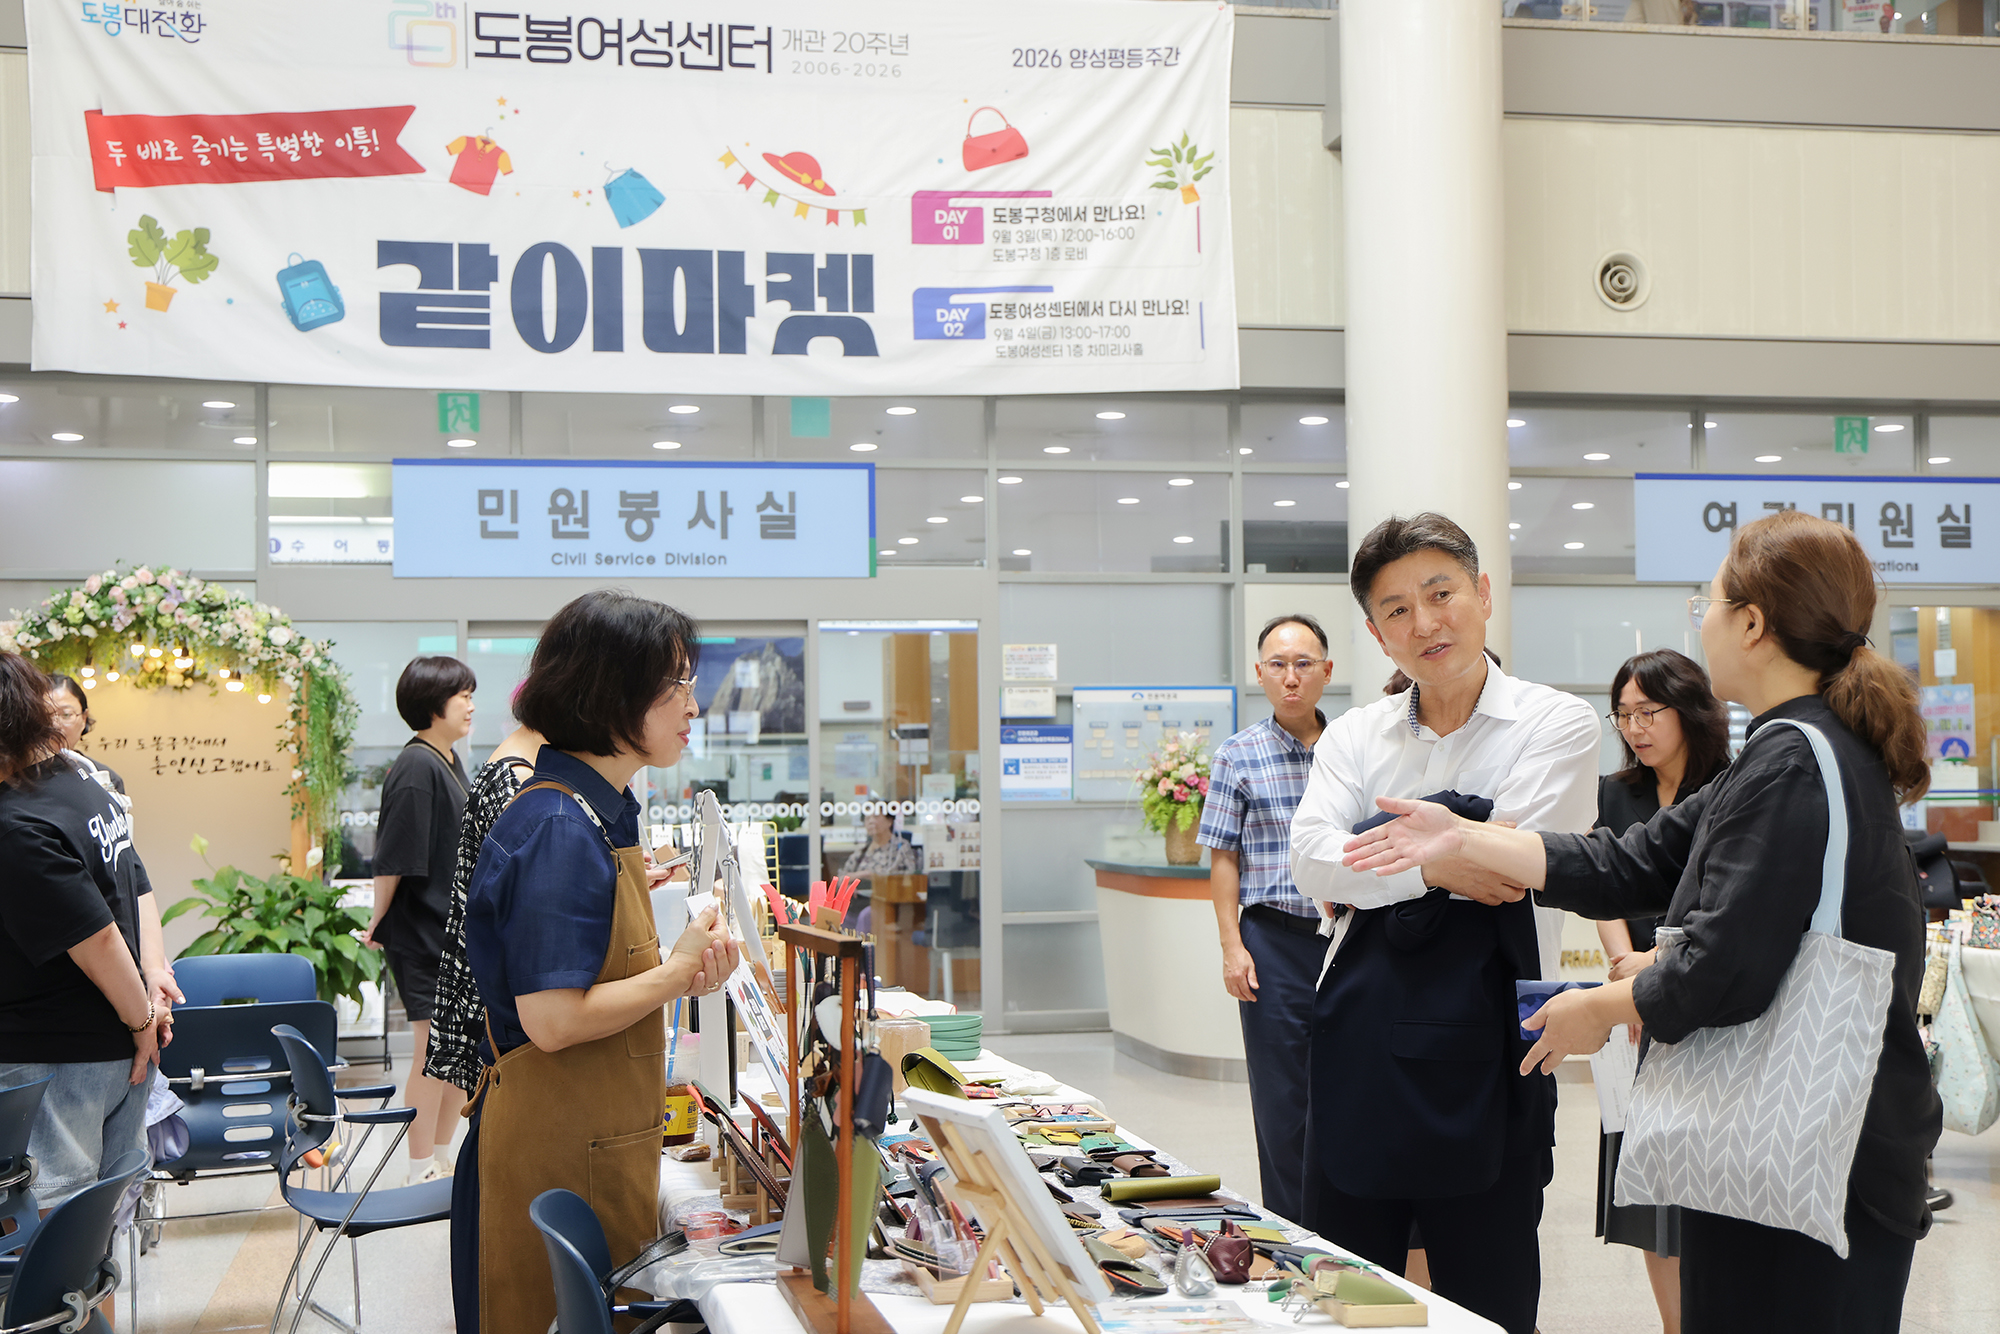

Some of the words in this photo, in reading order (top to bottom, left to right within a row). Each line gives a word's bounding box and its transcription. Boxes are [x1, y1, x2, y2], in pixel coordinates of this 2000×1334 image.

[80, 2, 207, 43] 도봉대전환
[474, 11, 772, 74] 도봉여성센터
[782, 29, 826, 53] 개관
[833, 31, 909, 56] 20주년
[1012, 48, 1062, 68] 2026
[1070, 46, 1181, 69] 양성평등주간
[792, 60, 902, 78] 2006-2026
[106, 140, 127, 167] 두
[137, 139, 184, 161] 배로
[191, 134, 249, 166] 즐기는
[256, 130, 324, 163] 특별한
[335, 125, 380, 158] 이틀!
[934, 209, 968, 225] DAY
[992, 205, 1087, 225] 도봉구청에서
[1093, 204, 1145, 223] 만나요!
[942, 225, 960, 240] 01
[992, 229, 1012, 244] 9월
[992, 247, 1041, 263] 도봉구청
[1046, 246, 1061, 262] 1층
[1065, 246, 1088, 262] 로비
[377, 240, 880, 357] 같이마켓
[936, 307, 970, 323] DAY
[989, 301, 1104, 320] 도봉여성센터에서
[1109, 300, 1137, 317] 다시
[1142, 299, 1190, 317] 만나요!
[943, 322, 964, 338] 02
[993, 327, 1014, 341] 9월
[995, 344, 1063, 359] 도봉여성센터
[1067, 344, 1084, 358] 1층
[478, 487, 796, 542] 민원봉사실
[551, 552, 586, 566] Civil
[595, 552, 656, 566] Service
[665, 552, 727, 566] Division
[98, 737, 128, 751] 우리
[136, 736, 227, 751] 도봉구청에서
